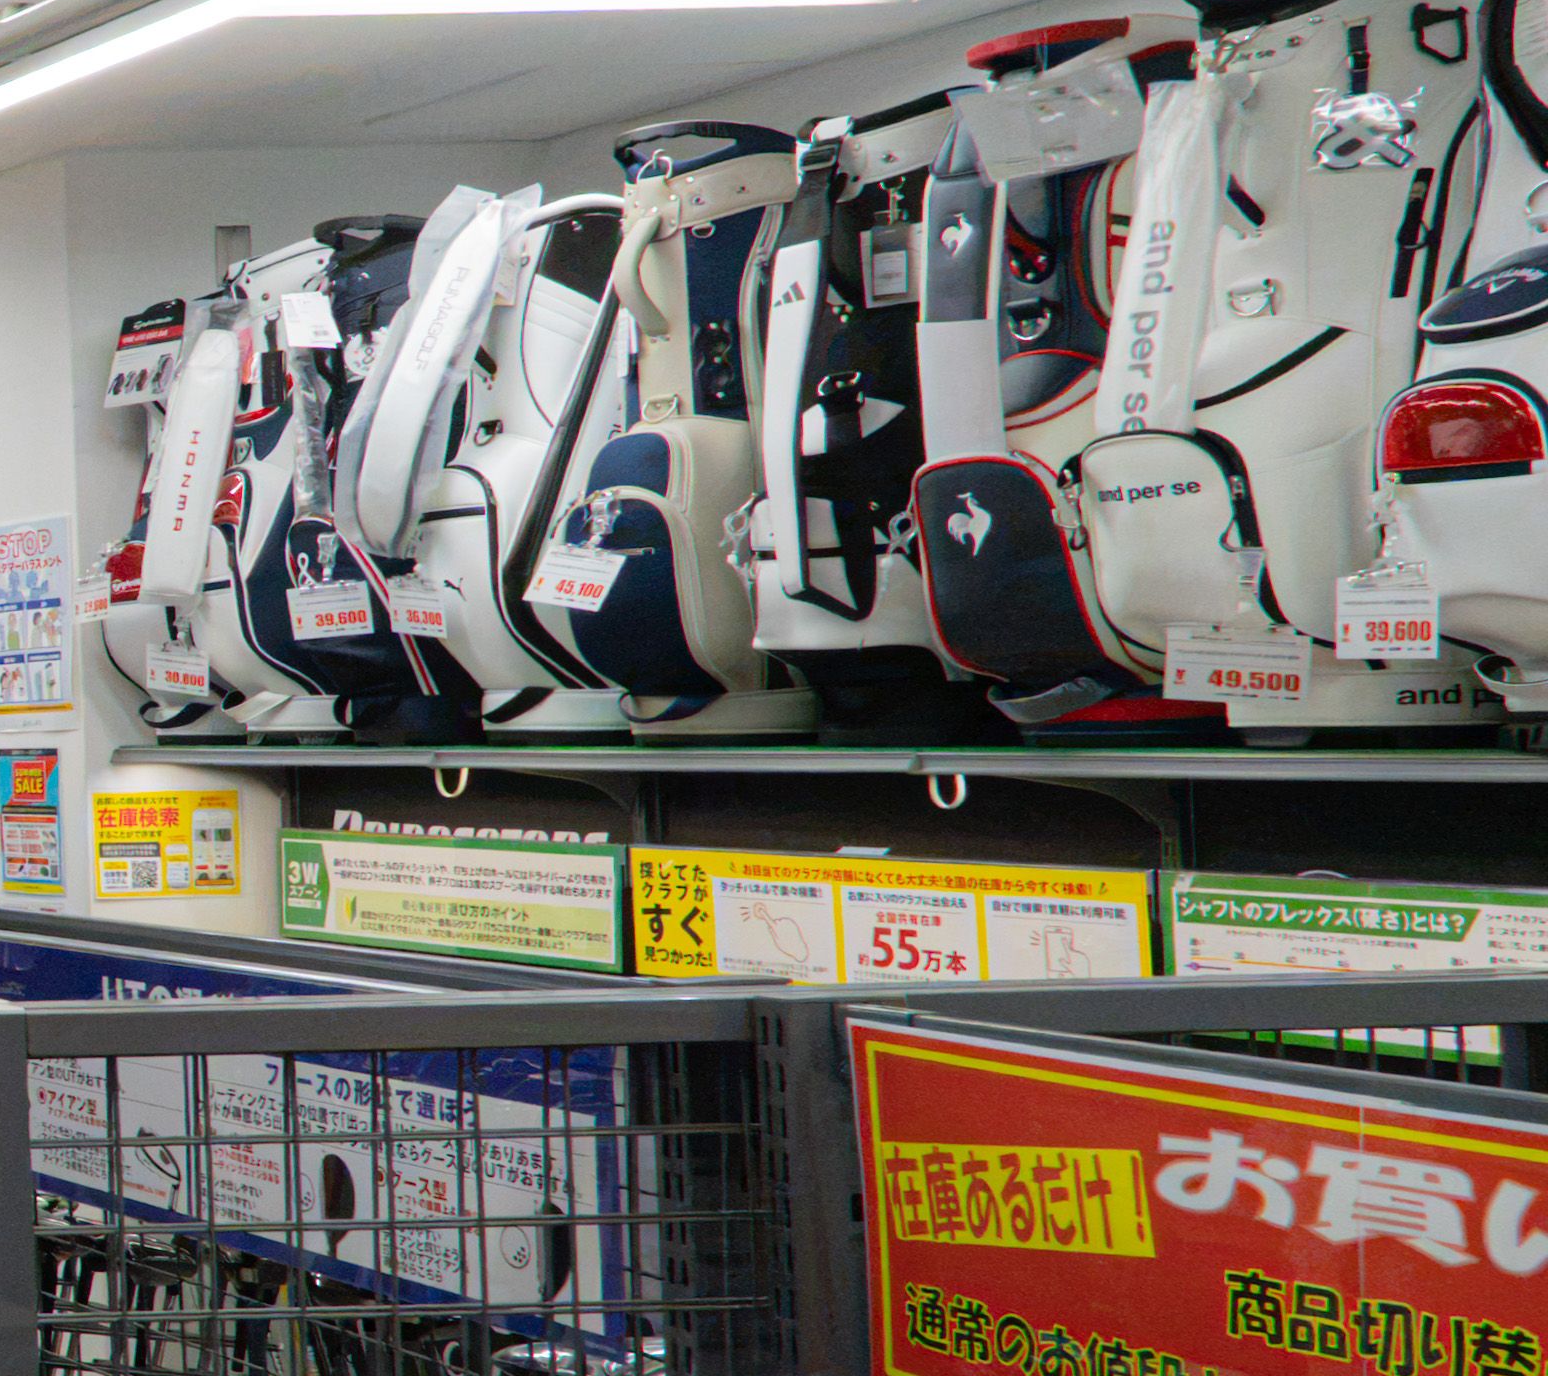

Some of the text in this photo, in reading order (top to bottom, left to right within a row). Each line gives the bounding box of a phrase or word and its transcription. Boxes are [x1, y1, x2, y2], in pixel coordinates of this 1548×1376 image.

[1141, 221, 1176, 296] and
[1132, 312, 1157, 379] per
[1099, 480, 1202, 504] and per se
[555, 578, 604, 600] 45,100
[314, 608, 368, 627] 39,600
[1364, 620, 1432, 642] 39,600
[1208, 668, 1301, 692] 49,500
[1397, 684, 1462, 706] and
[14, 777, 44, 795] SALE
[97, 807, 180, 829] 在庫検索
[287, 859, 321, 886] 3W
[639, 861, 709, 883] 探してた
[287, 885, 322, 899] スプーン
[641, 882, 709, 900] クラブが
[641, 903, 709, 946] すぐ
[1179, 895, 1467, 935] シャフトのフレックス(硬さ)とは?
[643, 946, 713, 968] 見つかった!
[883, 1143, 1149, 1252] 在庫あるだけ!
